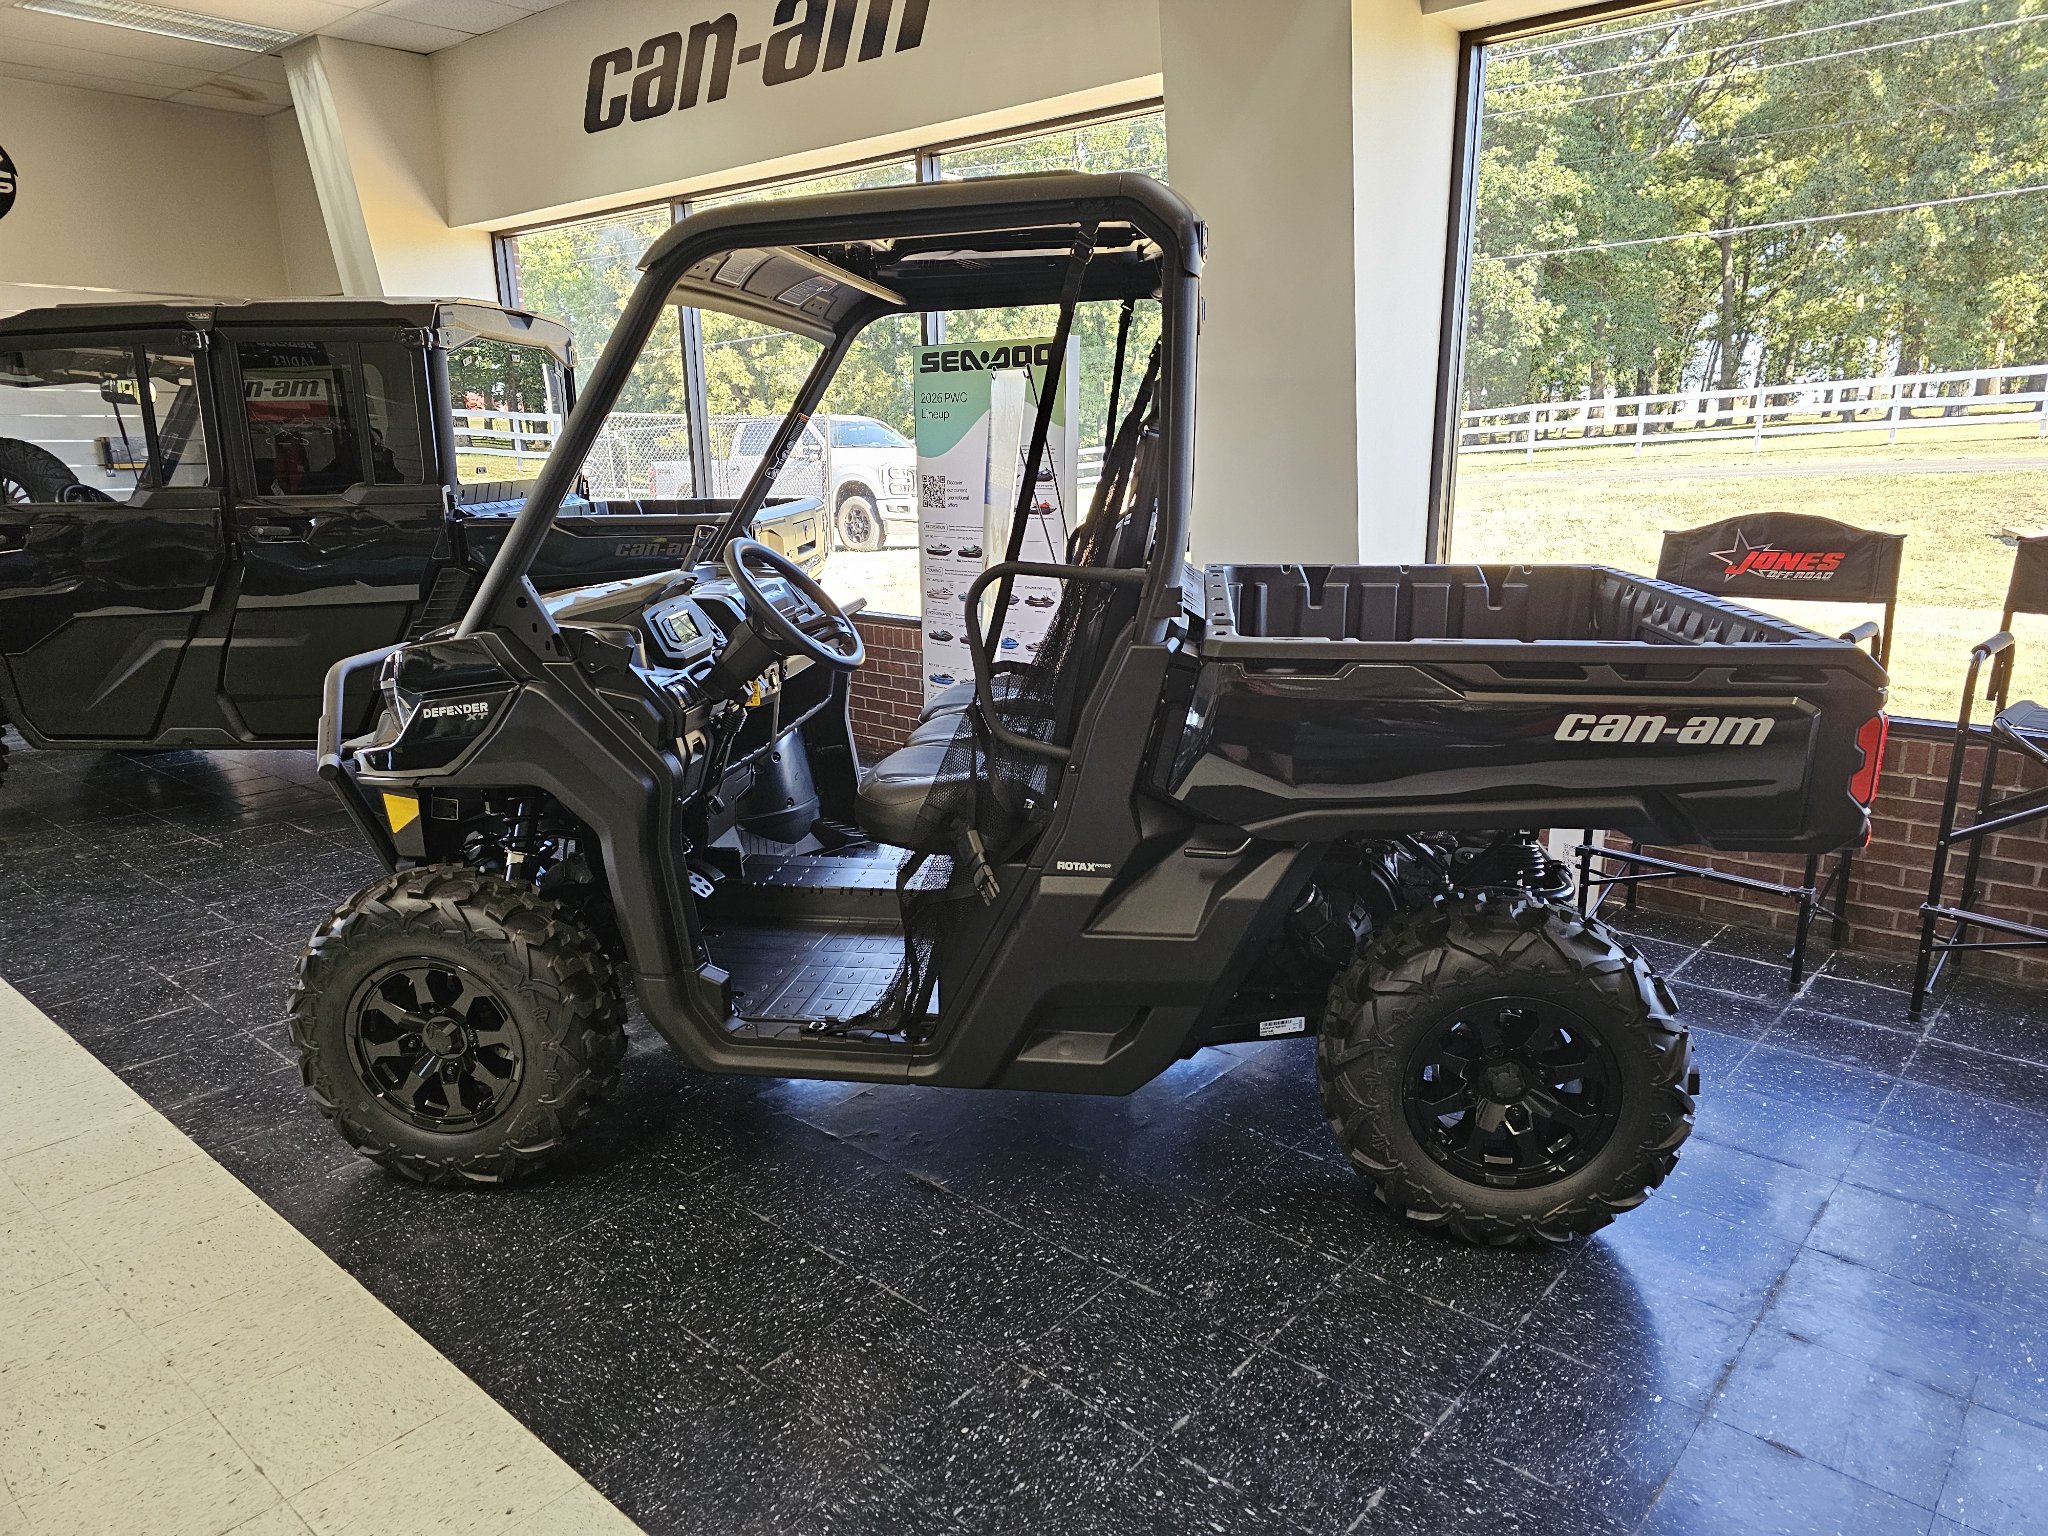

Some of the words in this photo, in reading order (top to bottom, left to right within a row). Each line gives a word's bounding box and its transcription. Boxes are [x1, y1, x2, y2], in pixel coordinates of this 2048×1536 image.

[584, 0, 930, 134] can-am
[245, 380, 320, 398] n-am
[920, 392, 943, 404] 2026
[944, 391, 968, 403] PWC
[921, 409, 950, 421] Lineup
[615, 543, 694, 557] can-a
[1724, 551, 1846, 576] JONES
[1766, 570, 1796, 579] OFF
[1793, 571, 1835, 580] ROAD
[422, 701, 489, 719] DEFENDER
[465, 711, 489, 721] XT
[1554, 713, 1776, 746] can-am
[1056, 861, 1096, 872] ROTAX
